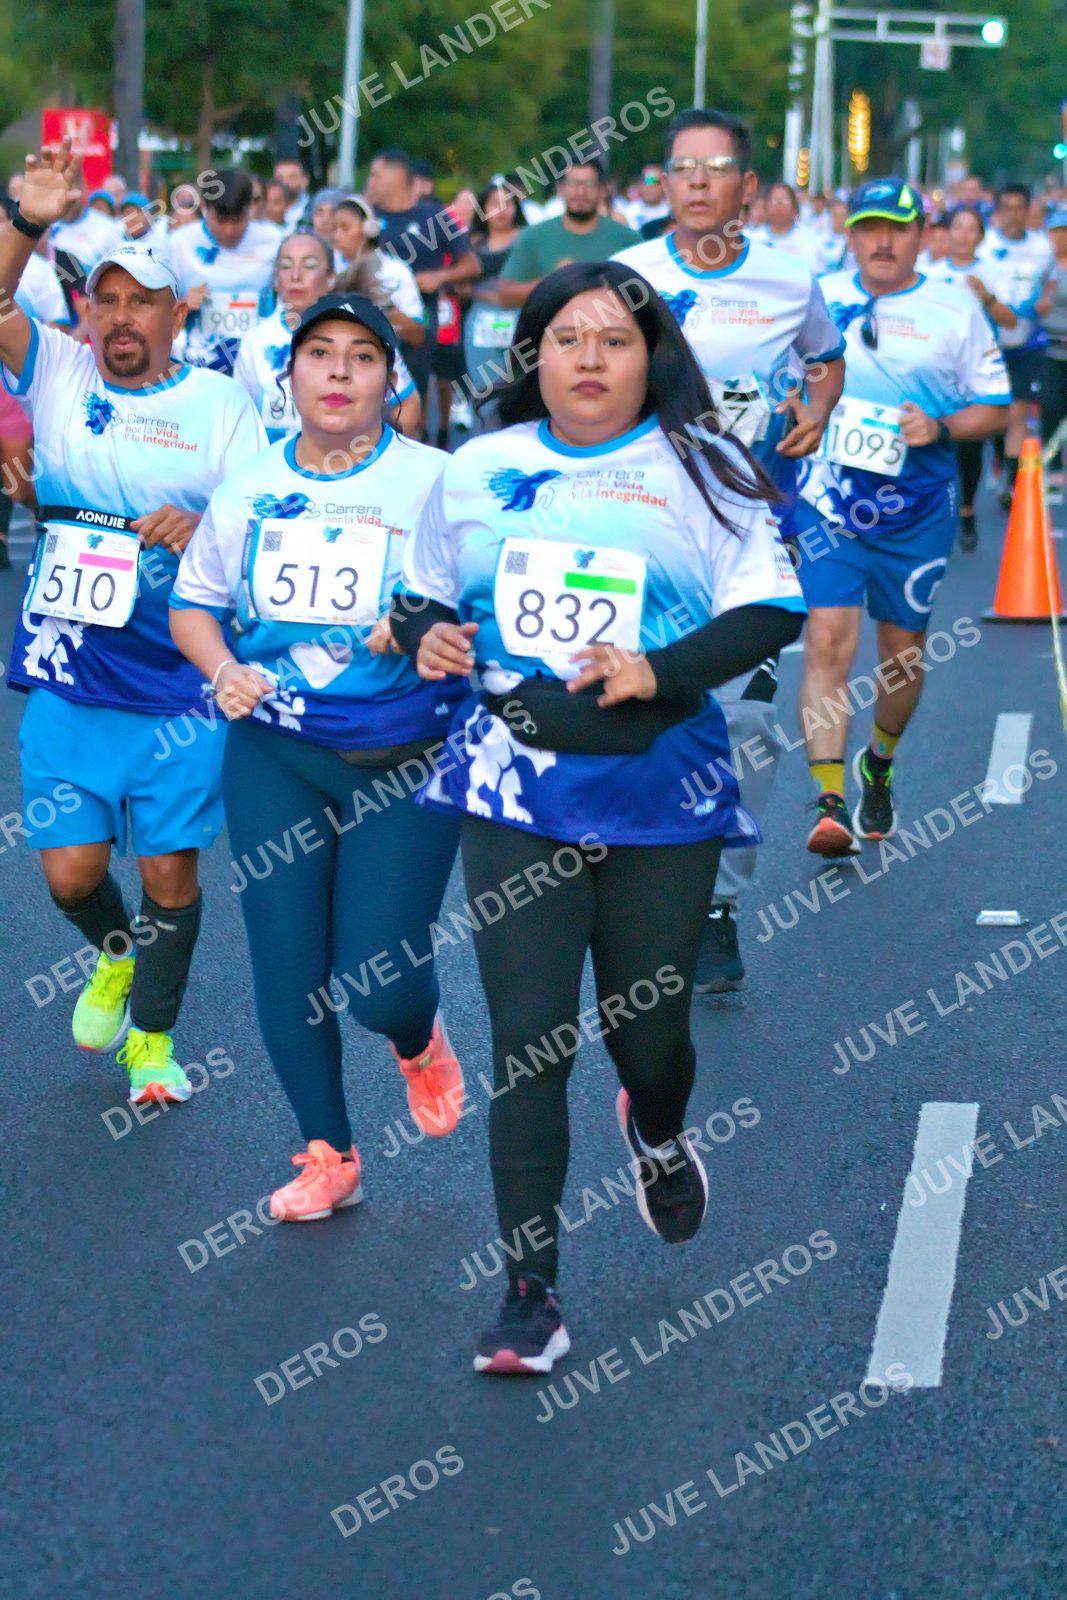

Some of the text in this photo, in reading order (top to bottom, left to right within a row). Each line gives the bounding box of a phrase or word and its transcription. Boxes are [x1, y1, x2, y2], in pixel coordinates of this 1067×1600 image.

[211, 312, 250, 332] 908
[127, 414, 180, 430] Carrera
[156, 427, 179, 439] Vida
[143, 434, 197, 451] Integridad
[831, 424, 902, 466] 1095
[597, 489, 667, 507] Integridad
[325, 502, 382, 516] Carrera
[356, 515, 382, 528] Vida
[42, 564, 116, 612] 510
[268, 563, 359, 611] 513
[515, 589, 617, 648] 832
